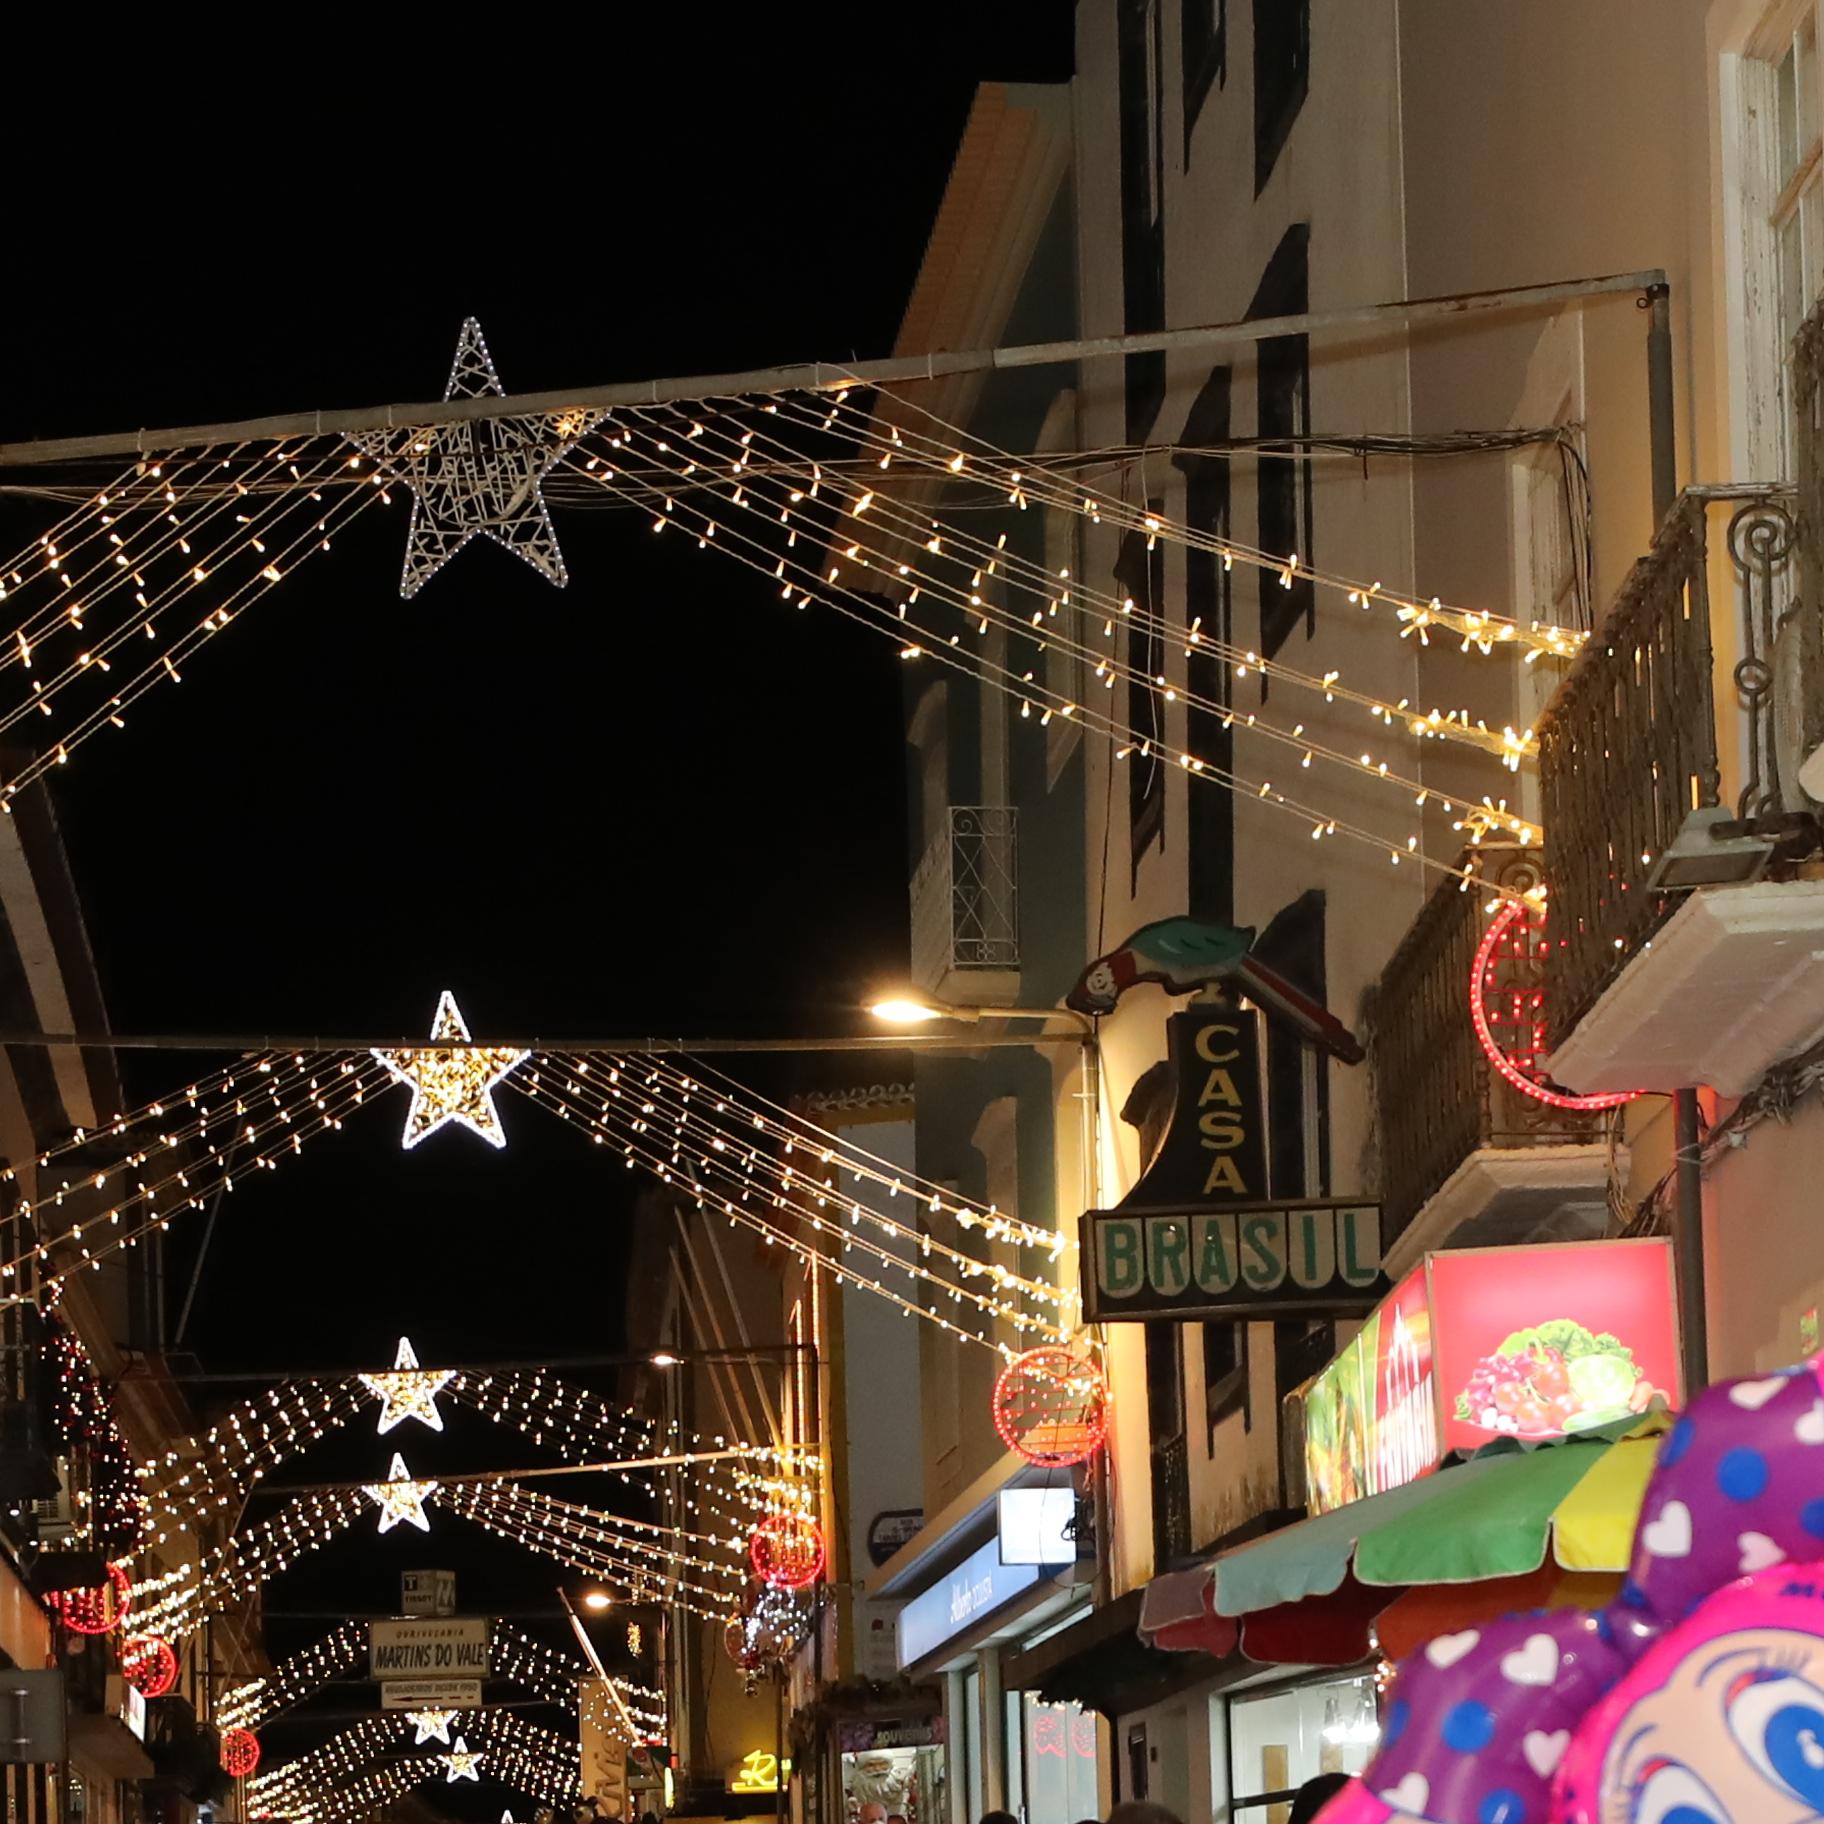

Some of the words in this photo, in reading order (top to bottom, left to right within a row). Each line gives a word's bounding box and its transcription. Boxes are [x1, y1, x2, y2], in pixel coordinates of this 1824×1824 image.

[1194, 1022, 1248, 1196] CASA
[1103, 1211, 1379, 1294] BRASIL
[375, 1643, 433, 1669] MARTINS
[434, 1643, 453, 1667] DO
[456, 1642, 484, 1667] VALE
